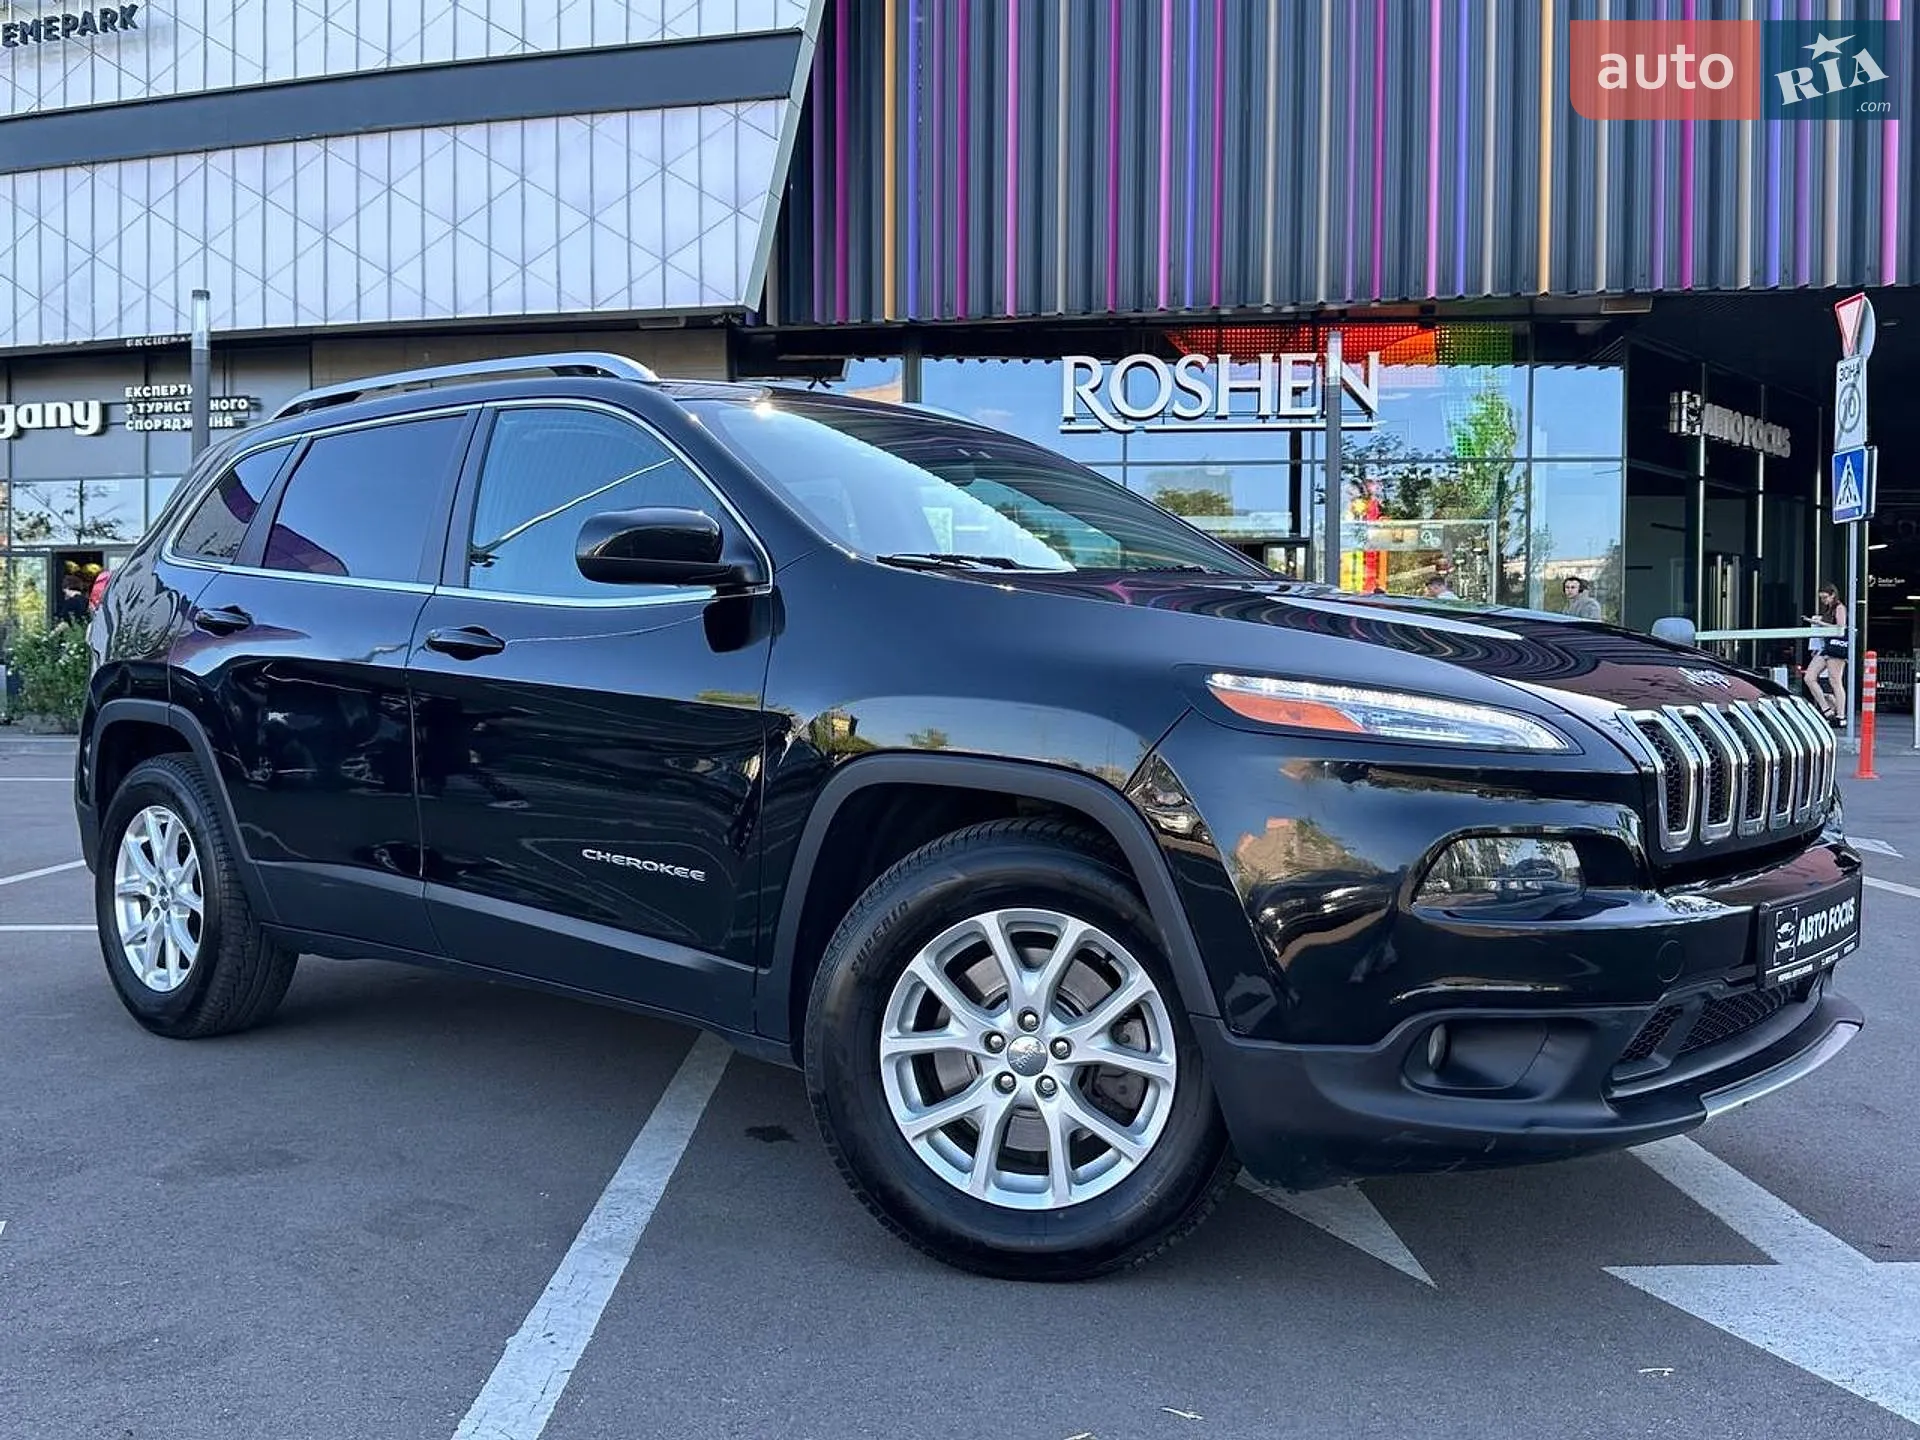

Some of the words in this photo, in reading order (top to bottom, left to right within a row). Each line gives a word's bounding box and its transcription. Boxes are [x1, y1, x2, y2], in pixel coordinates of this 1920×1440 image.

[2, 4, 139, 47] EMEPARK
[138, 398, 248, 414] ТУРИСТНОГО
[1061, 353, 1380, 431] ROSHEN
[0, 400, 100, 440] gany
[581, 848, 706, 882] CHEROKEE
[1797, 916, 1827, 946] АВТО
[1828, 897, 1855, 932] FOCUS
